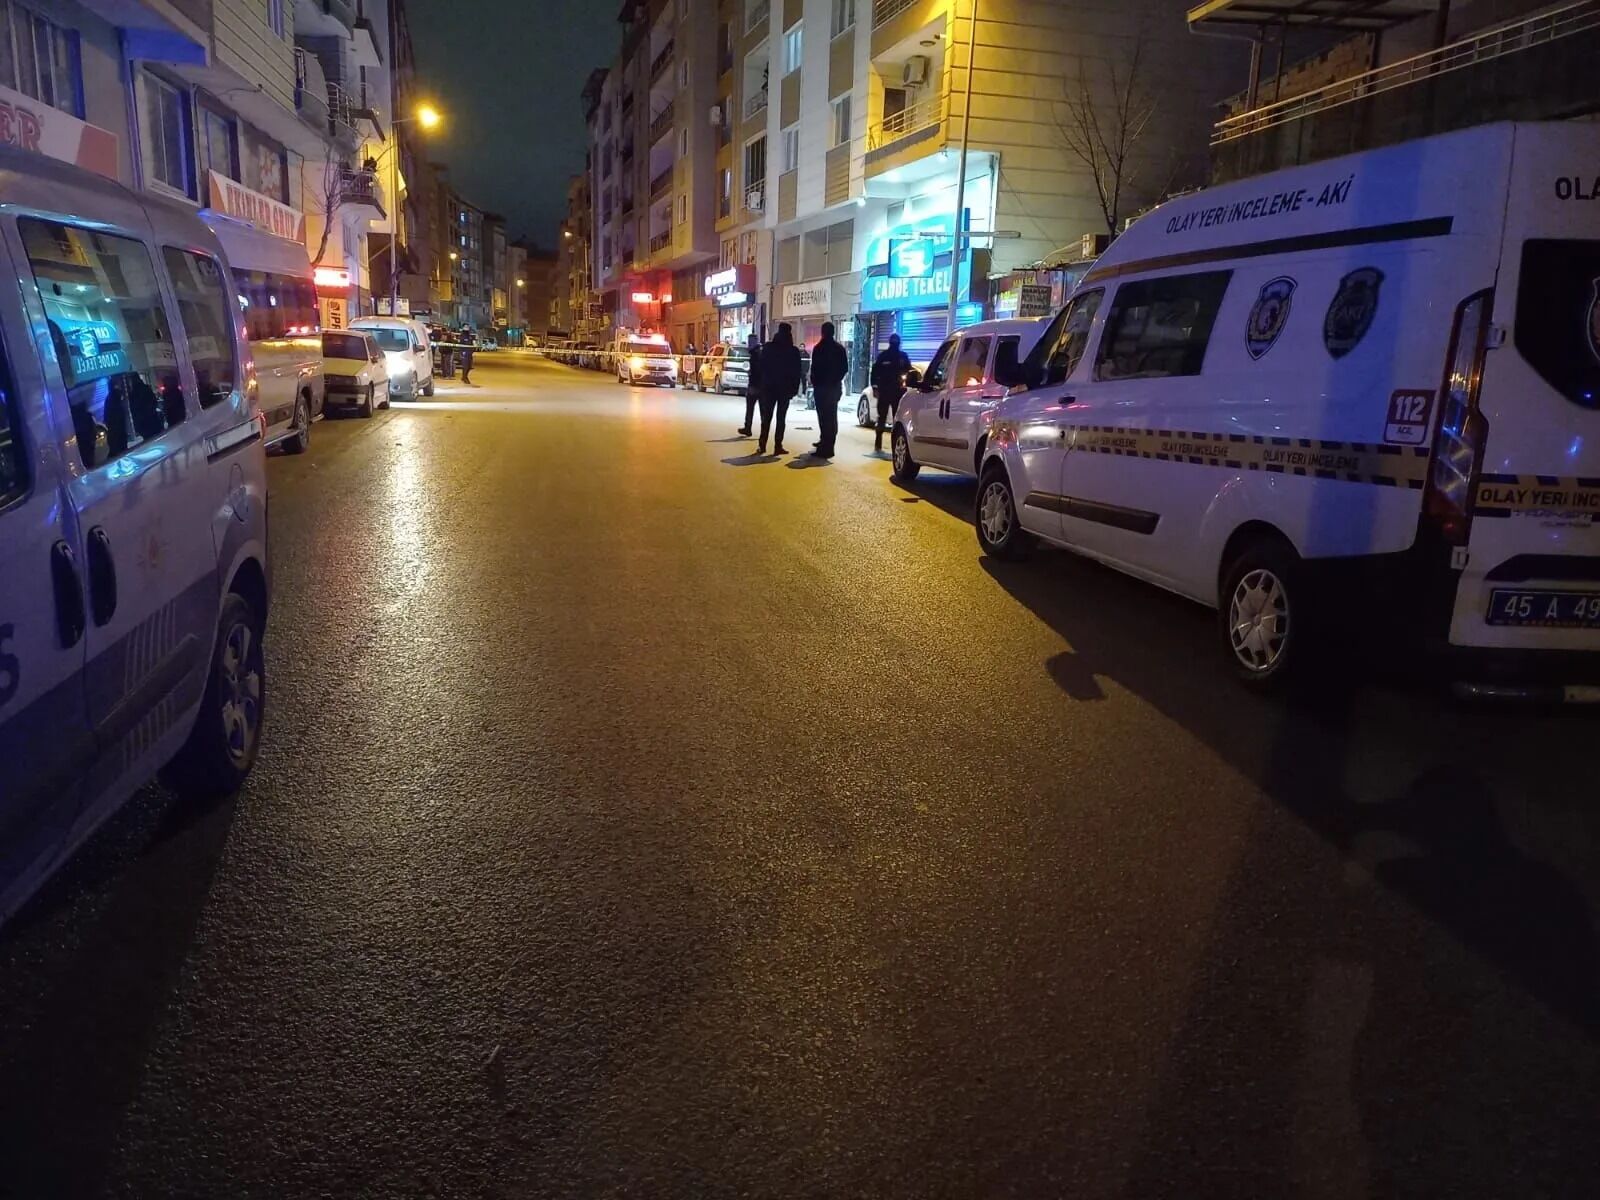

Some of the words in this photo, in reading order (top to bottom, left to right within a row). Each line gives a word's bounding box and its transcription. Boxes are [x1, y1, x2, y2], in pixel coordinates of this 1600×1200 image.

[1166, 212, 1197, 234] OLAY
[1316, 173, 1355, 207] AKİ
[874, 279, 910, 301] CADDE
[914, 271, 951, 296] TEKEL
[1395, 396, 1426, 422] 112
[1481, 488, 1528, 504] OLAY
[1504, 595, 1534, 617] 45
[1545, 596, 1558, 618] A
